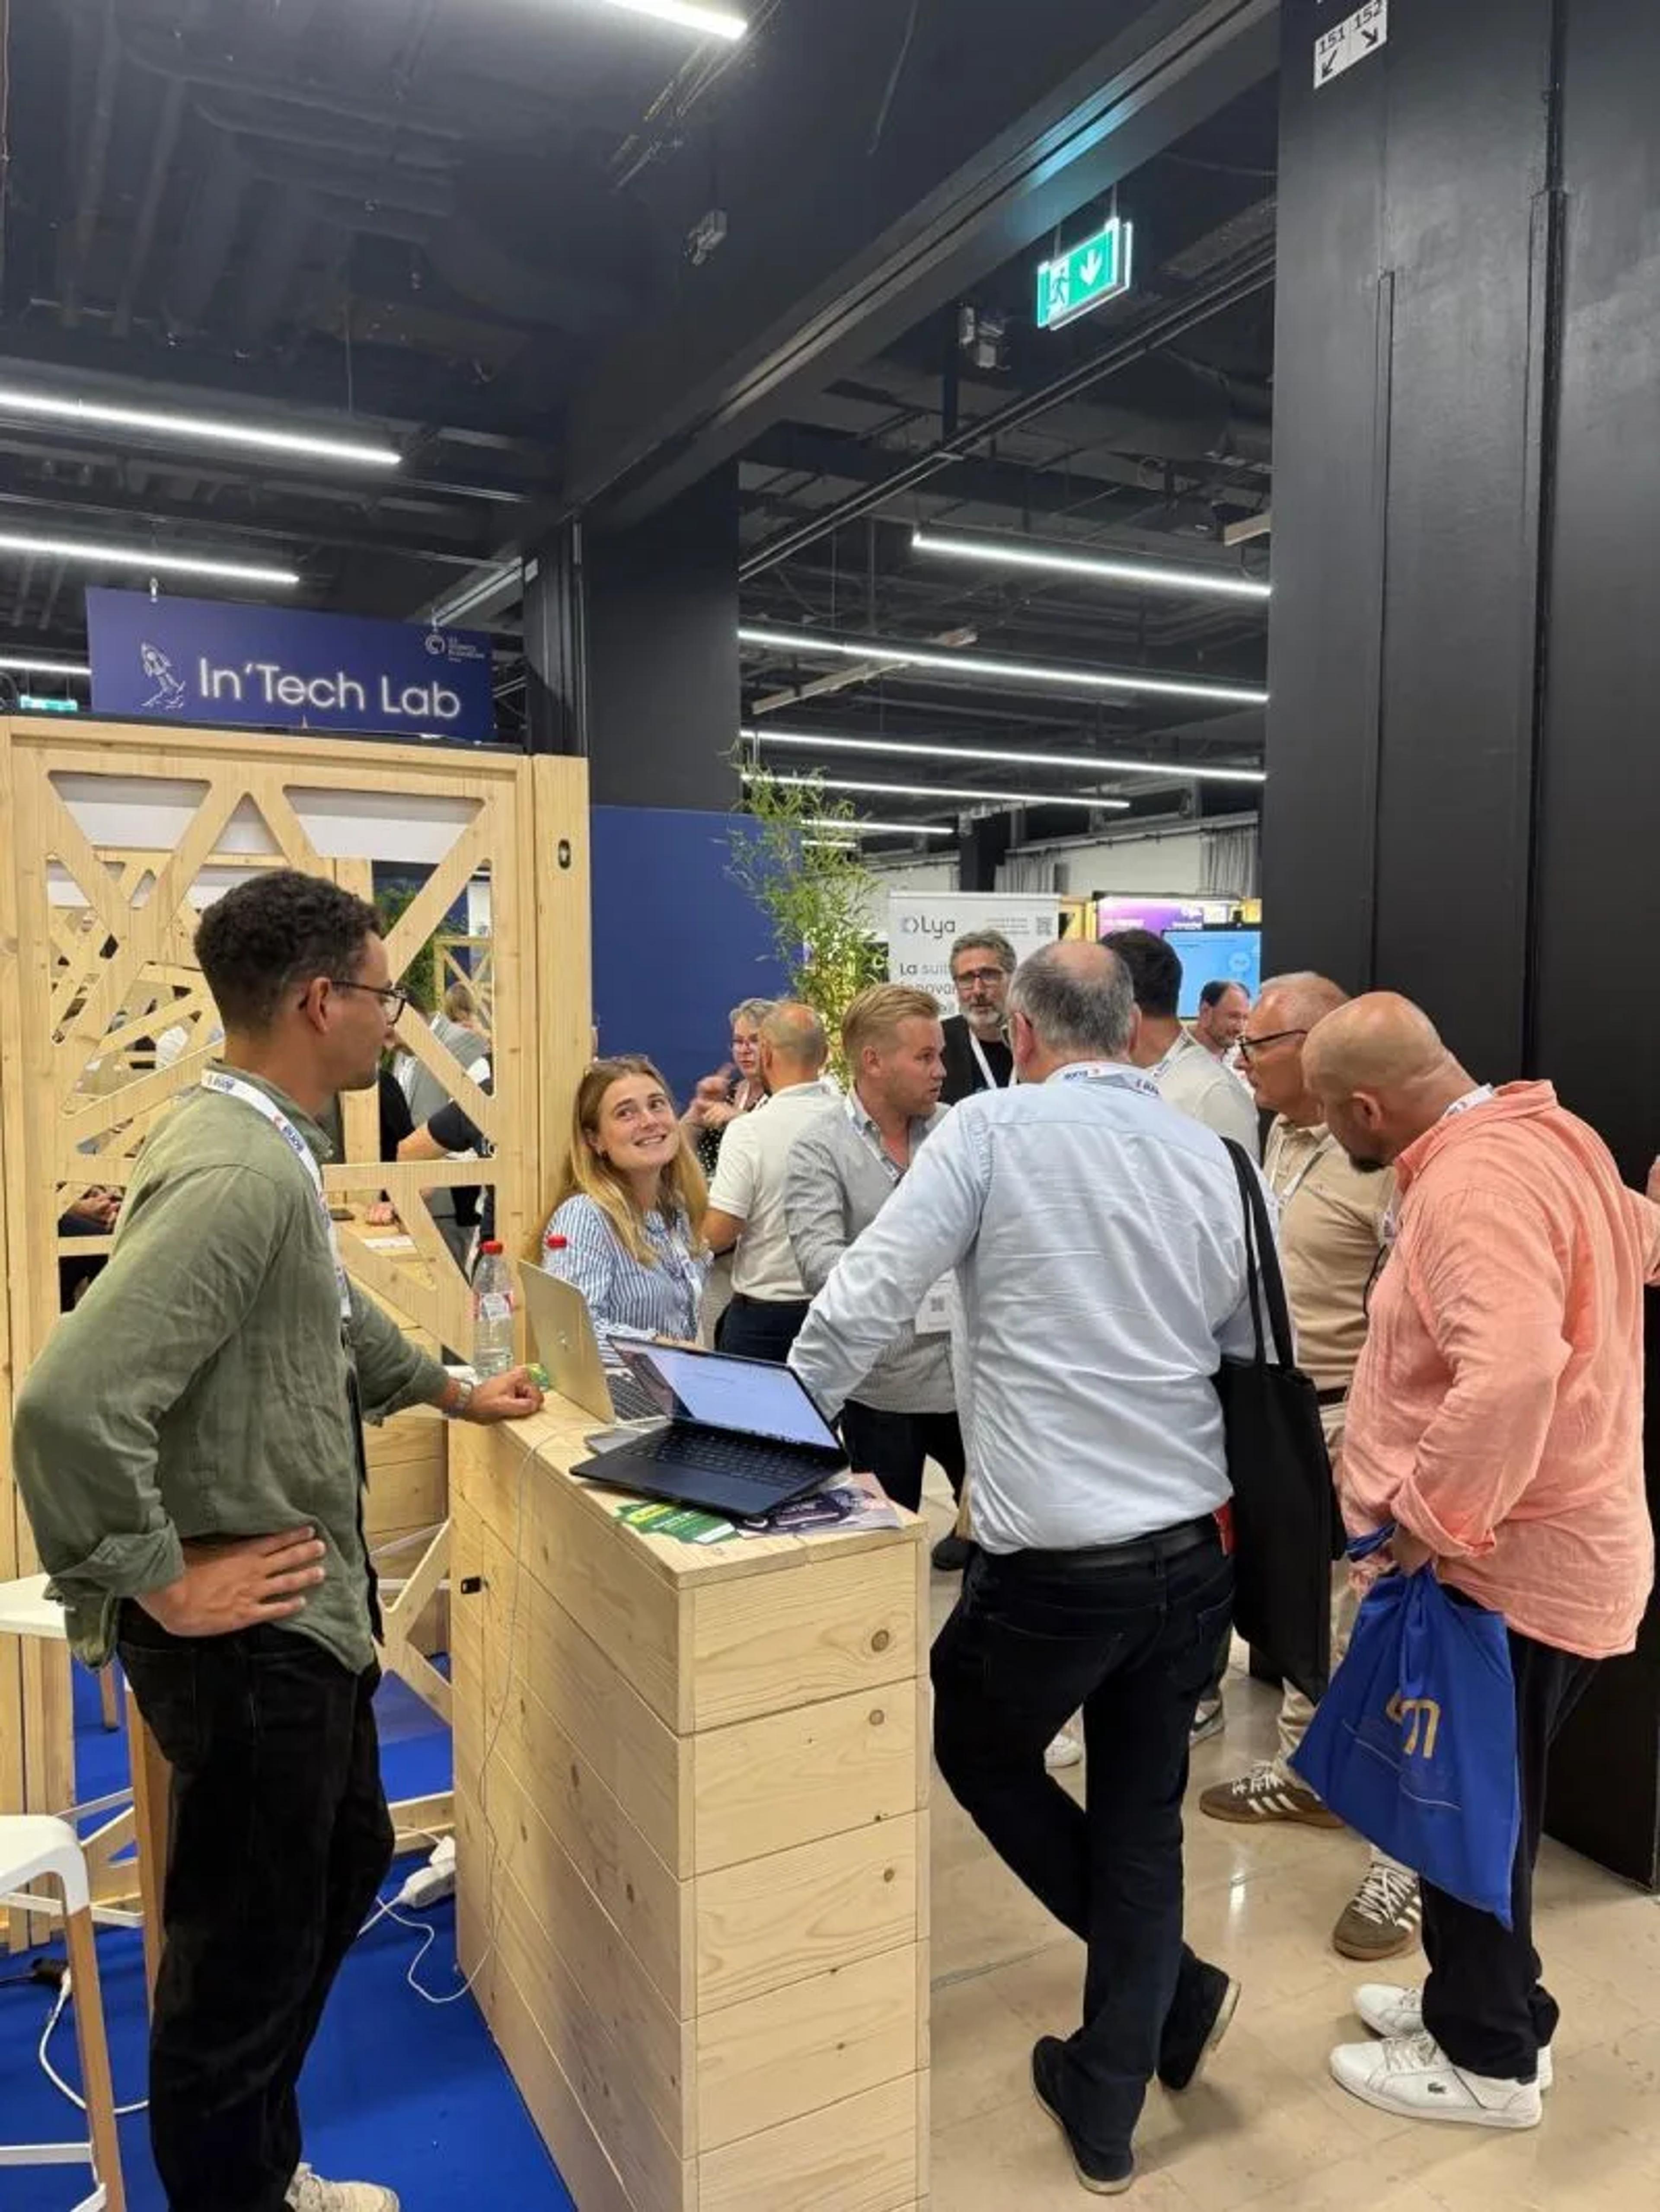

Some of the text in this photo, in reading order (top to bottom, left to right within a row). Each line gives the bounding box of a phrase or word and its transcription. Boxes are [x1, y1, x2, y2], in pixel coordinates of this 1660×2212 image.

[1320, 26, 1345, 54] 151
[200, 658, 461, 718] In'Tech Lab
[921, 915, 955, 939] Lya
[900, 963, 949, 976] La suit
